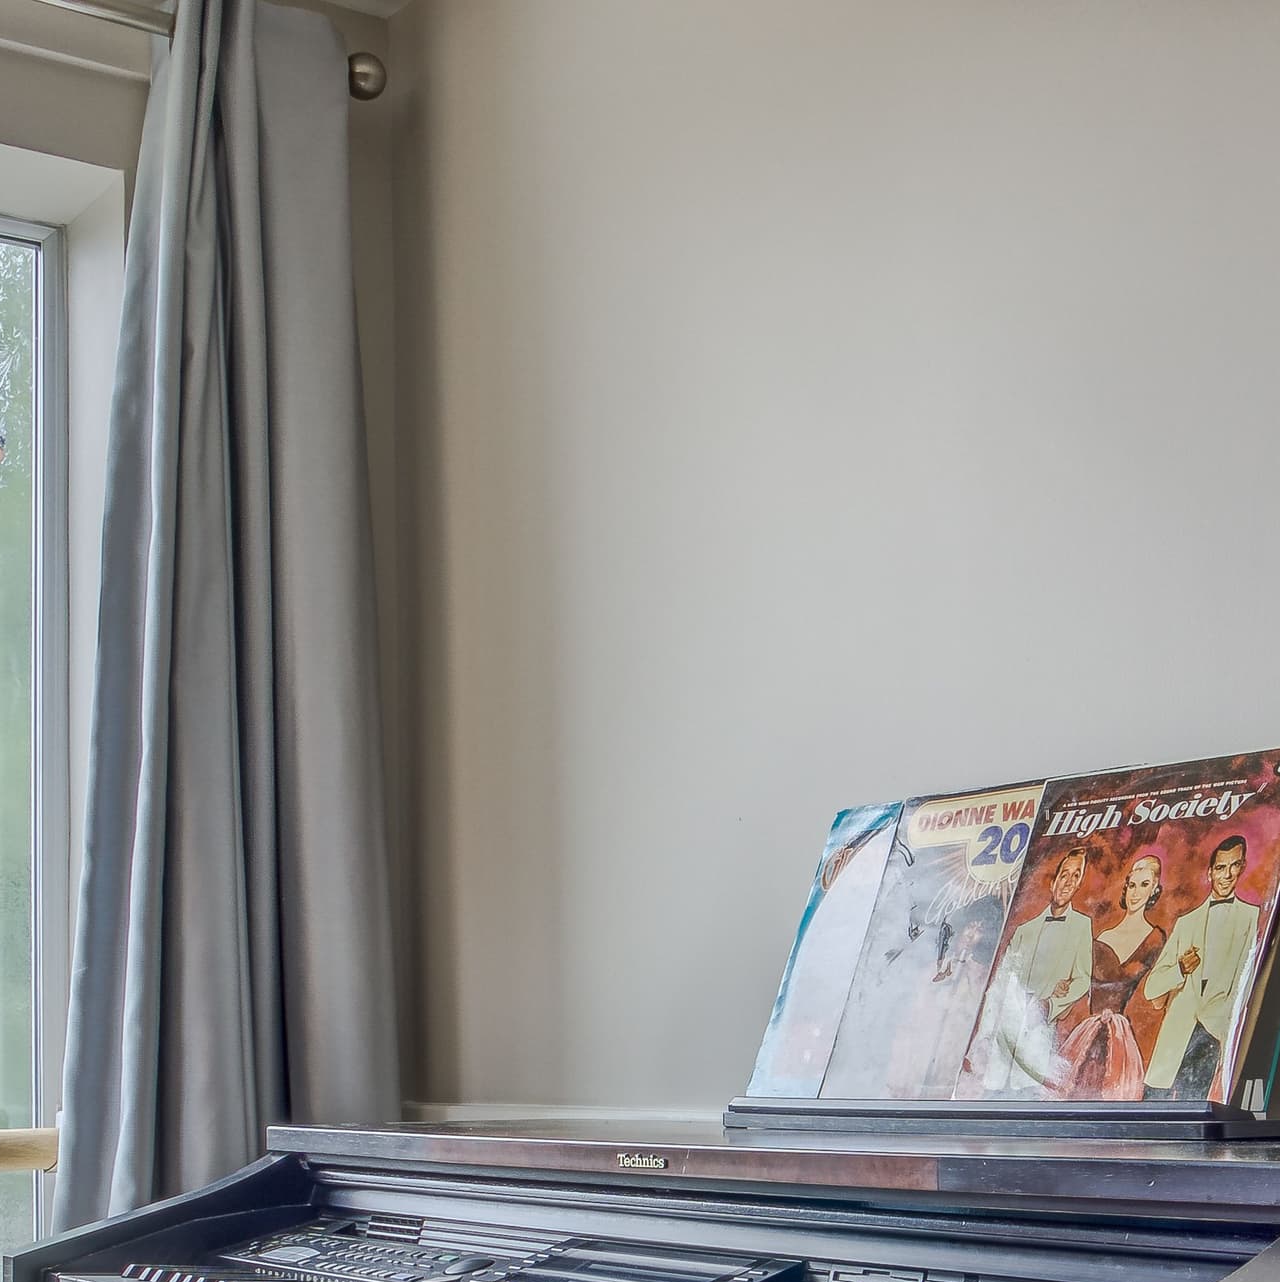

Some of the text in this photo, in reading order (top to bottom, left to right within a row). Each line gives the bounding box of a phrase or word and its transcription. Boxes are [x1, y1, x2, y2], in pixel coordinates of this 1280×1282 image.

[918, 804, 997, 831] DIONNE
[971, 822, 1030, 866] 20
[616, 1152, 665, 1169] Technics
